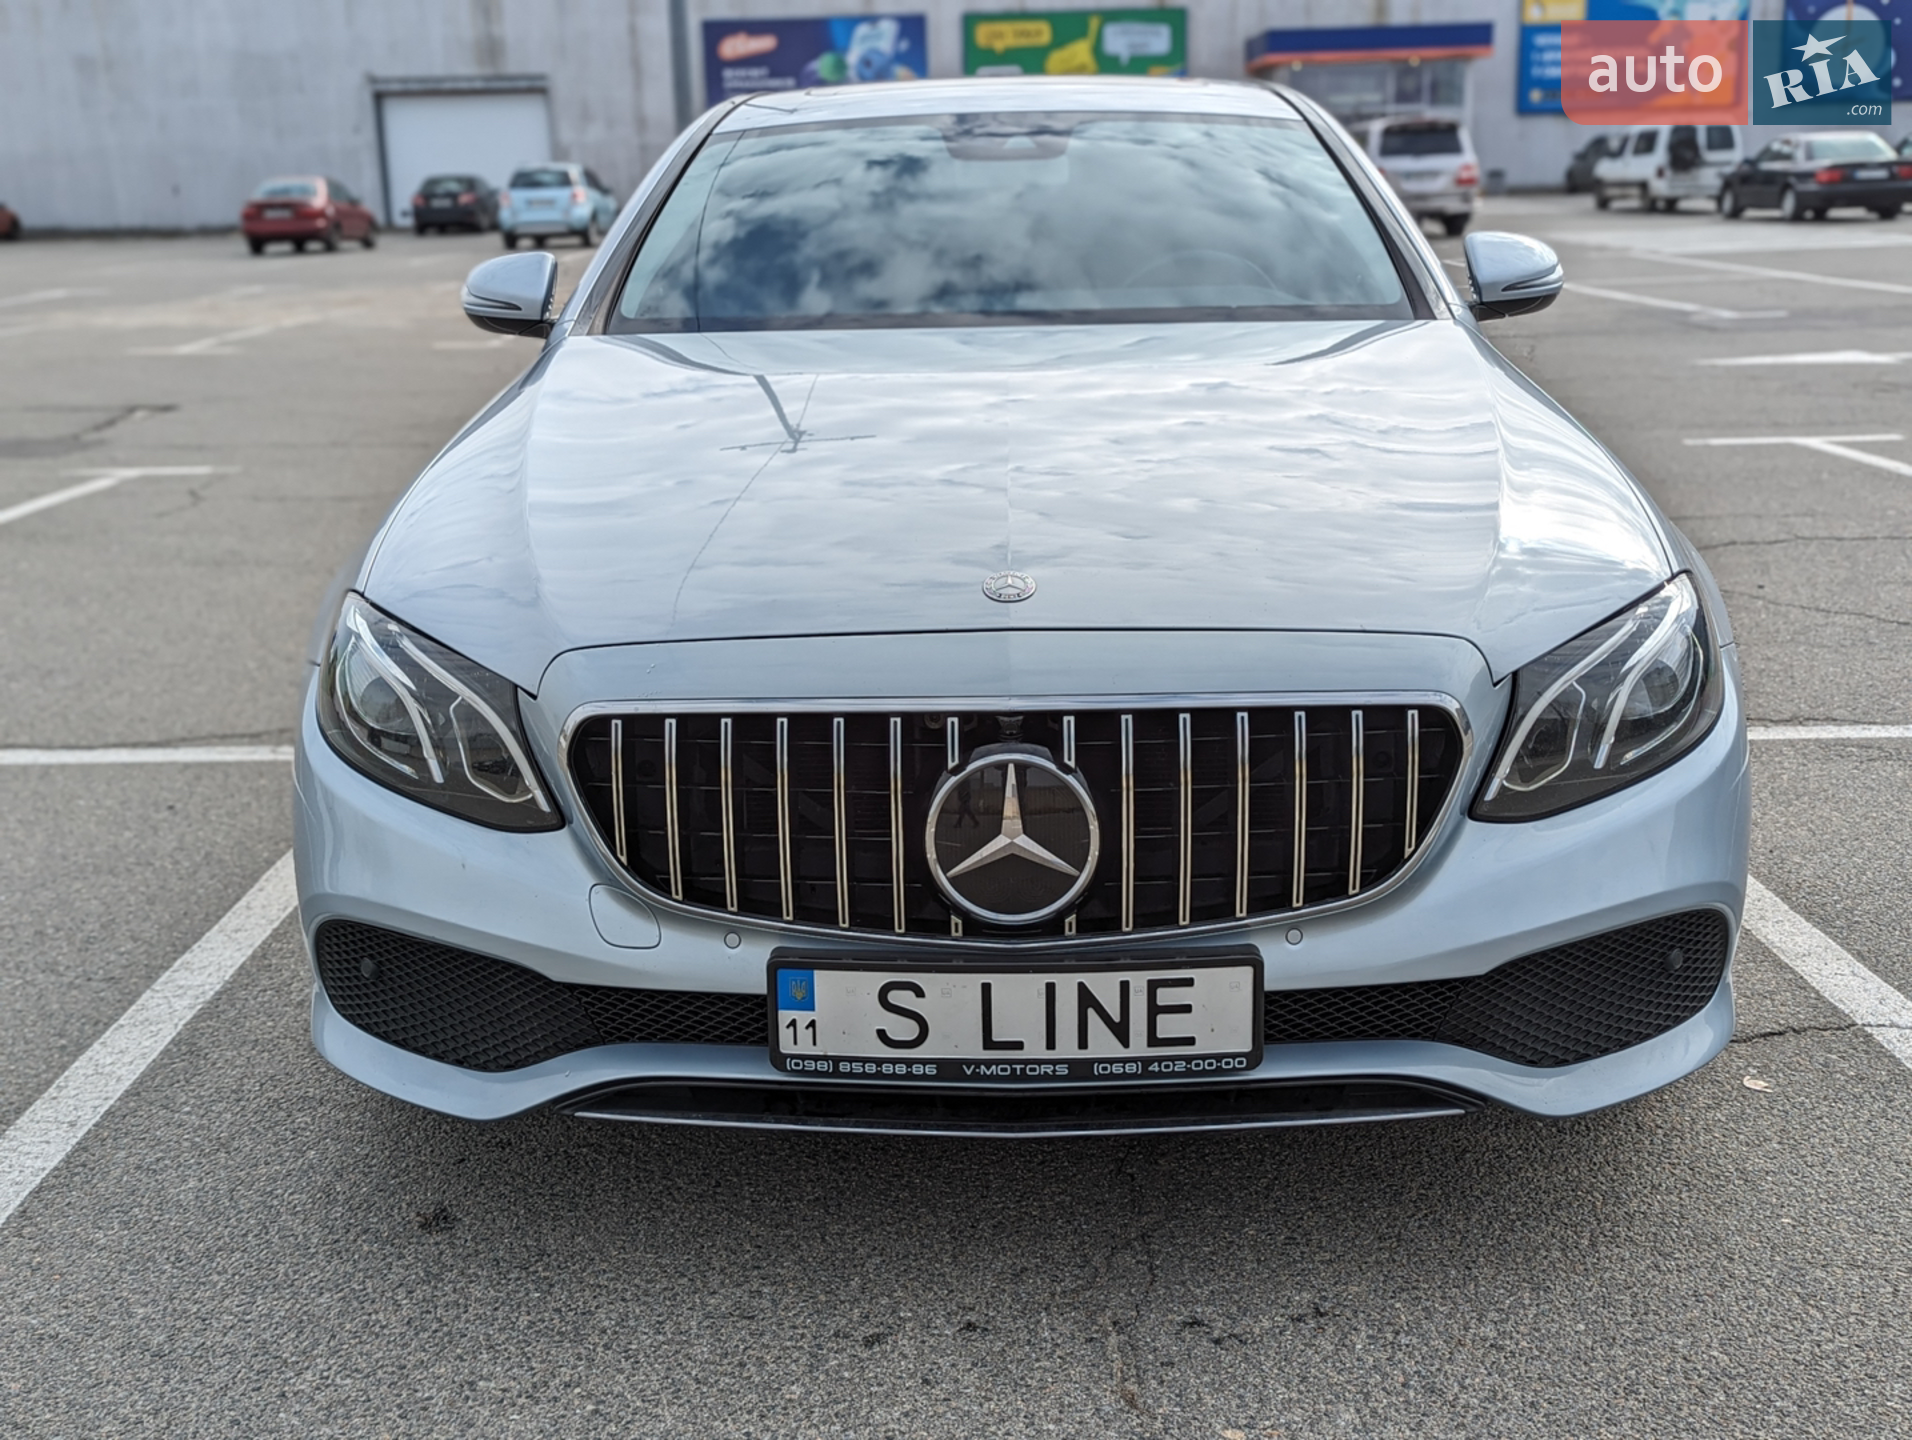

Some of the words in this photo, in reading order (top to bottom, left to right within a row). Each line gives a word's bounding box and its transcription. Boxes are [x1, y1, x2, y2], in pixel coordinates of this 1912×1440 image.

[875, 980, 930, 1050] S
[980, 976, 1197, 1051] LINE
[785, 1017, 818, 1047] 11
[786, 1057, 834, 1073] (098)
[838, 1060, 938, 1076] 858-88-86
[962, 1063, 1069, 1076] V-MOTORS
[1093, 1060, 1143, 1075] (068)
[1147, 1056, 1248, 1073] 402-00-00
